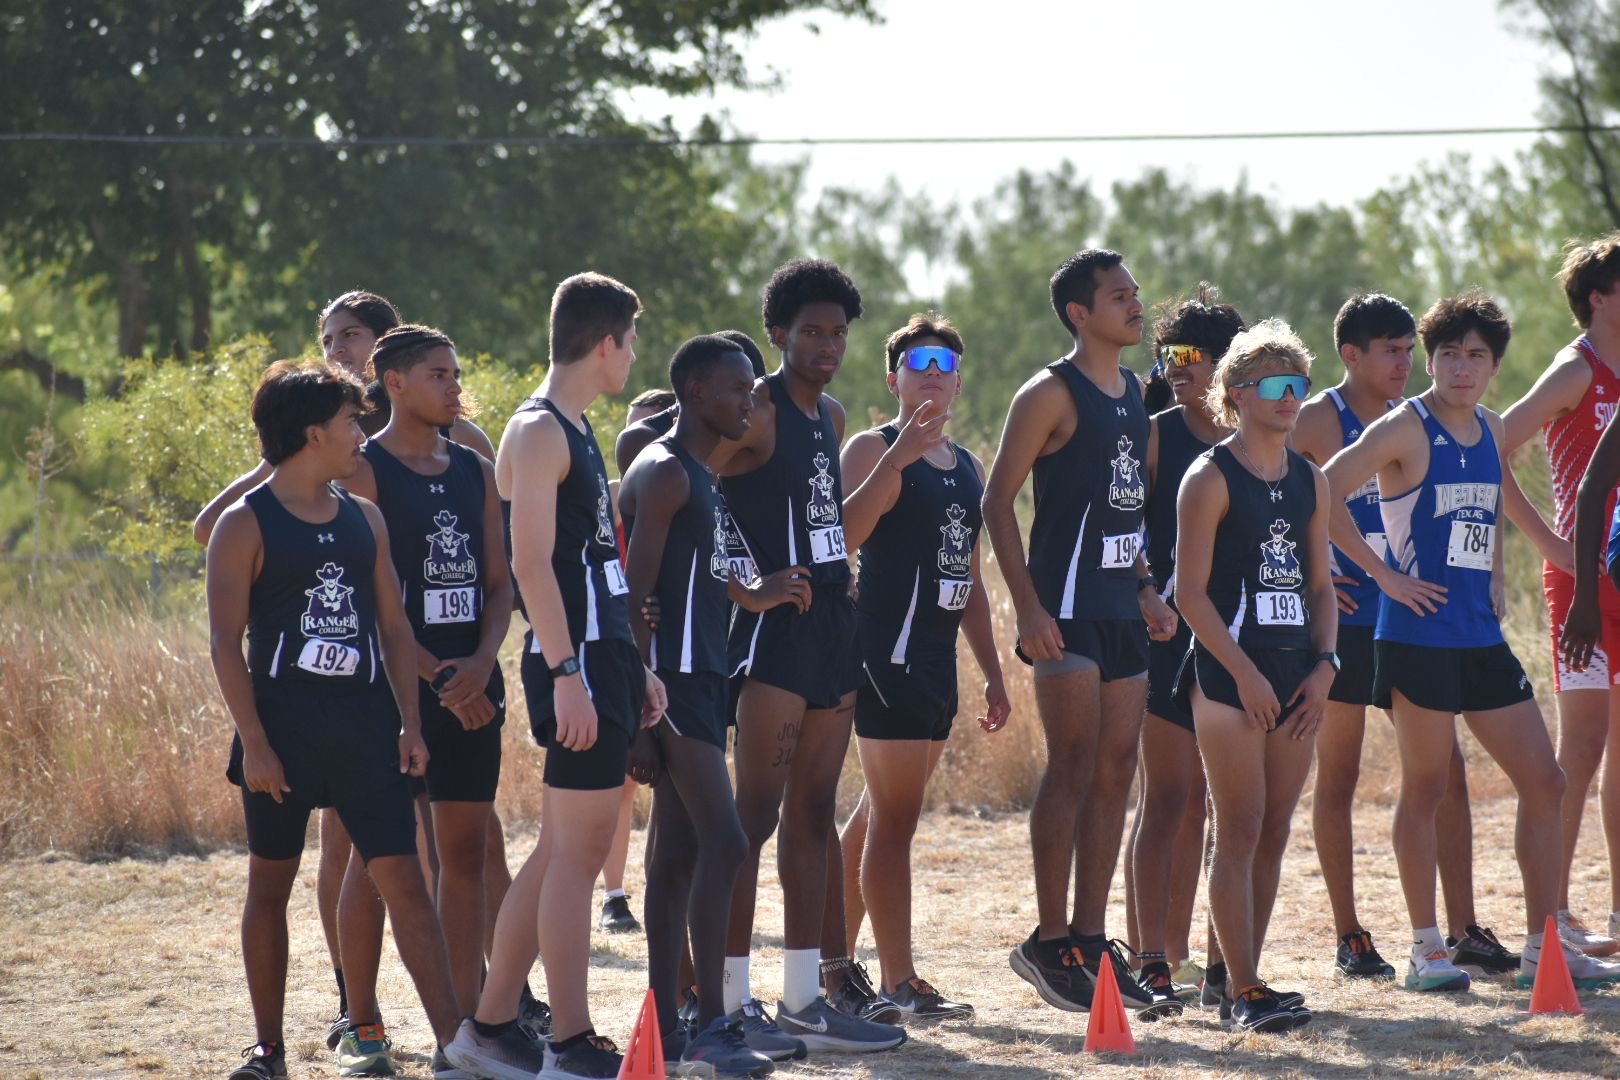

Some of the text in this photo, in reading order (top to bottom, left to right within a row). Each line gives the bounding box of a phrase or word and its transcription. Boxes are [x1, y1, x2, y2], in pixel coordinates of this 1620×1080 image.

[1456, 509, 1484, 520] TEXAS
[1113, 536, 1137, 564] 196
[1463, 523, 1490, 554] 784
[426, 559, 474, 577] RANGER
[441, 572, 466, 580] COLLEGE
[729, 559, 748, 584] 94
[439, 590, 470, 619] 198
[1269, 594, 1297, 621] 193
[303, 613, 358, 631] RANGER
[318, 626, 347, 635] COLLEGE
[311, 643, 349, 672] 192
